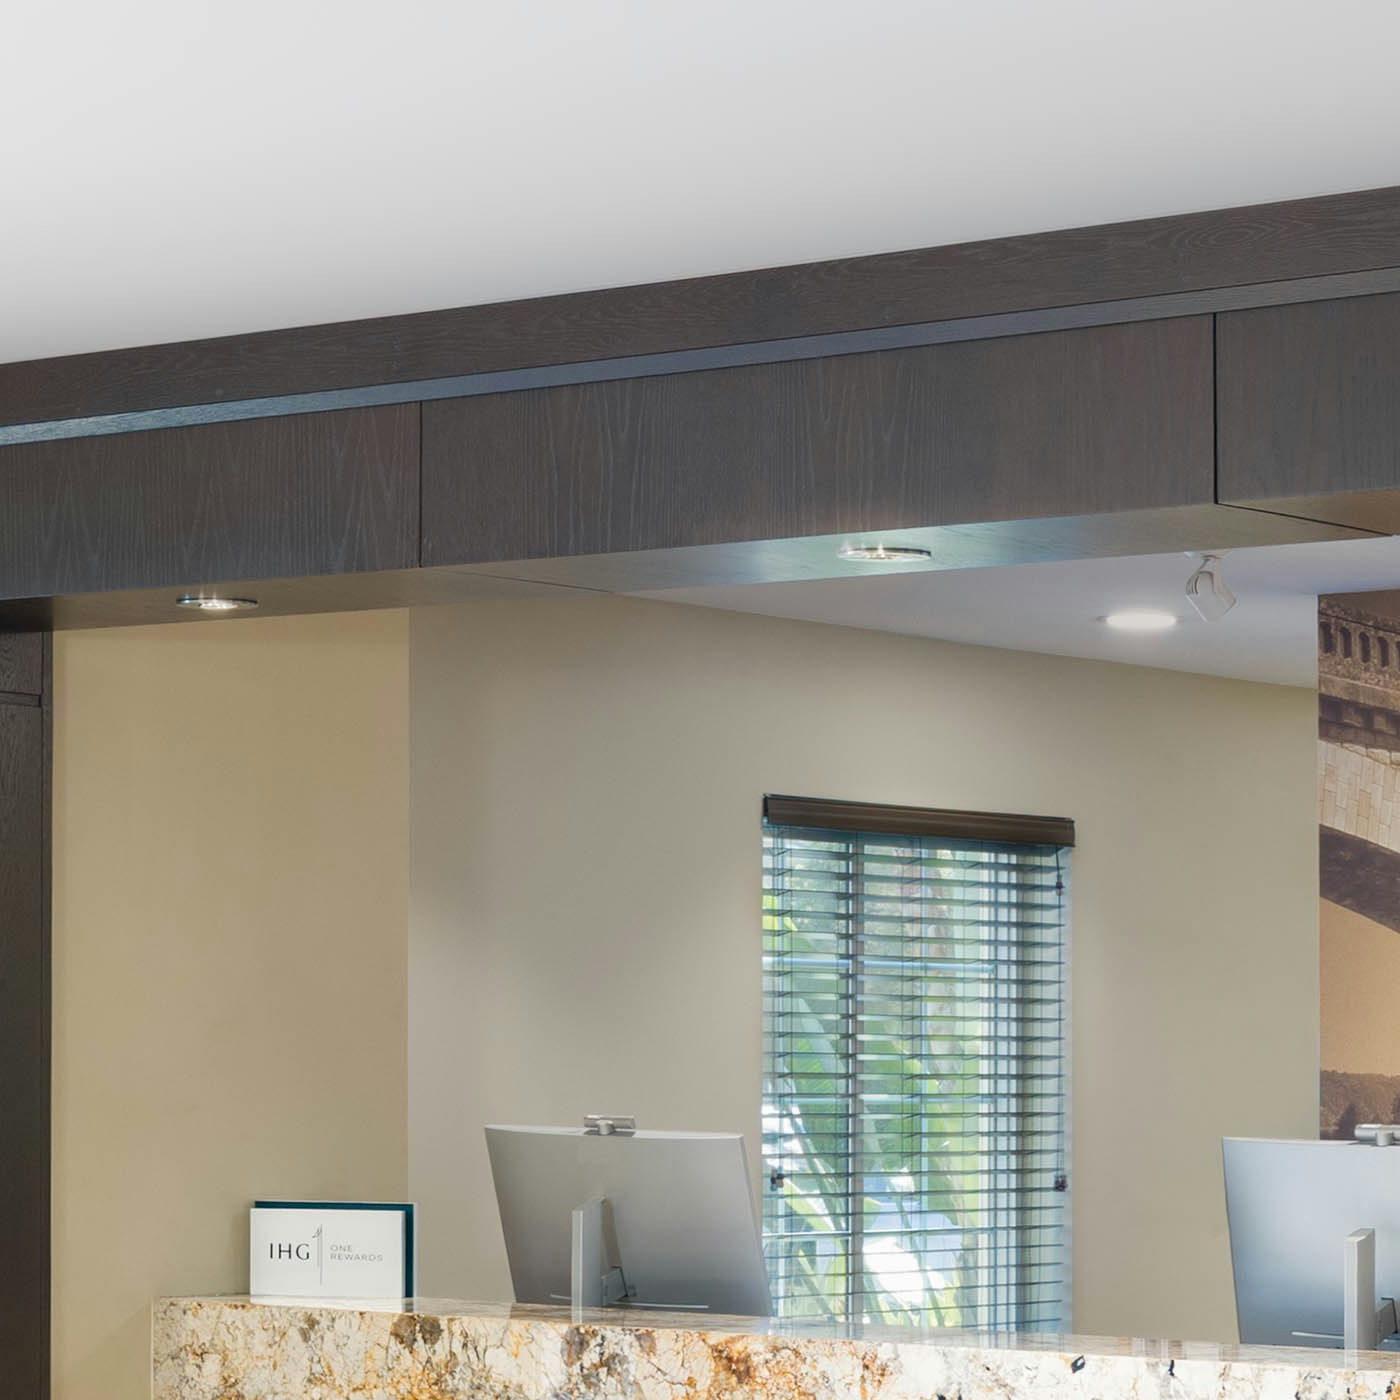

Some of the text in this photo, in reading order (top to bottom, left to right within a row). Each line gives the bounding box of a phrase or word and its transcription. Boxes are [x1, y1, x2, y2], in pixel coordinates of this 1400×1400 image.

[269, 1243, 310, 1261] IHG
[330, 1244, 354, 1252] ONE
[330, 1254, 383, 1262] REWARDS
